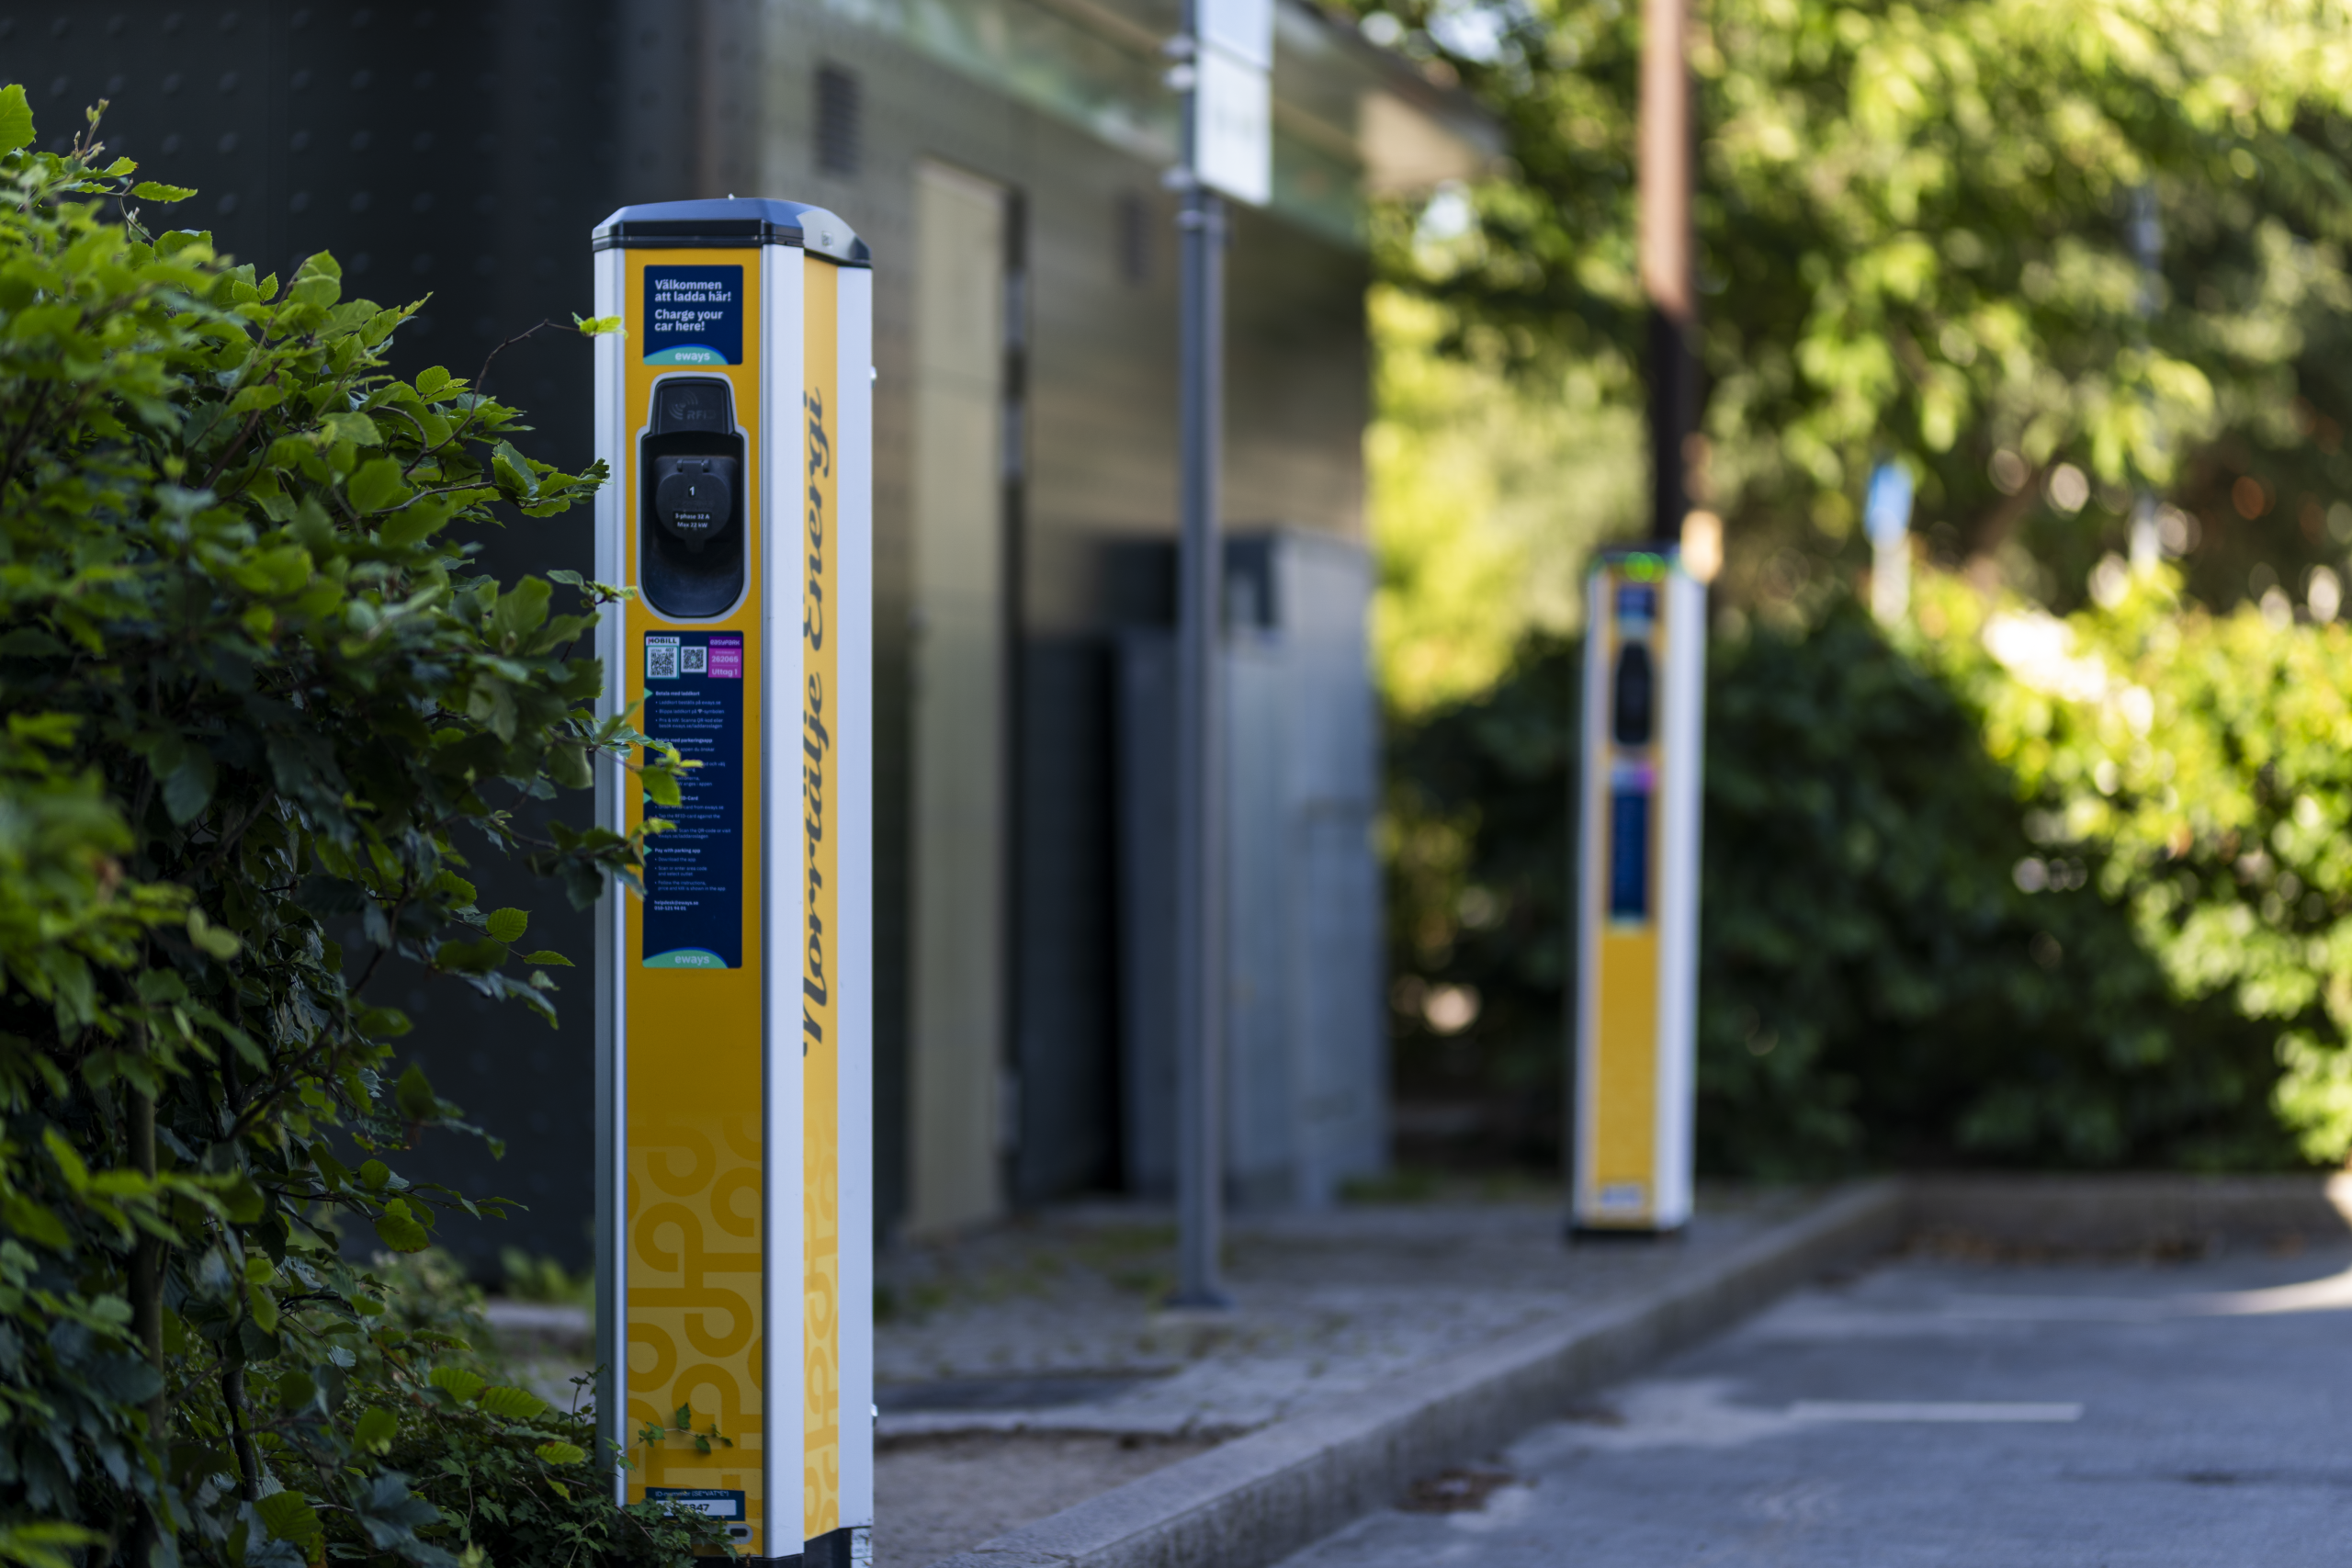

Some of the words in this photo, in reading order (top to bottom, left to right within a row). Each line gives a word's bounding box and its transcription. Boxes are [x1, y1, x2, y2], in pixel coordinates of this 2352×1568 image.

[654, 278, 722, 290] Välkommen
[654, 291, 672, 302] att
[673, 290, 706, 302] ladda
[708, 290, 731, 302] här!
[654, 309, 695, 321] Charge
[696, 310, 723, 321] your
[654, 321, 673, 332] car
[675, 320, 705, 332] here!
[674, 352, 710, 363] eways
[689, 486, 695, 496] 1
[802, 386, 830, 652] Energi
[711, 655, 739, 663] 262065
[711, 668, 733, 678] Uttag
[802, 672, 829, 1057] Norrtälje
[674, 955, 710, 966] eways
